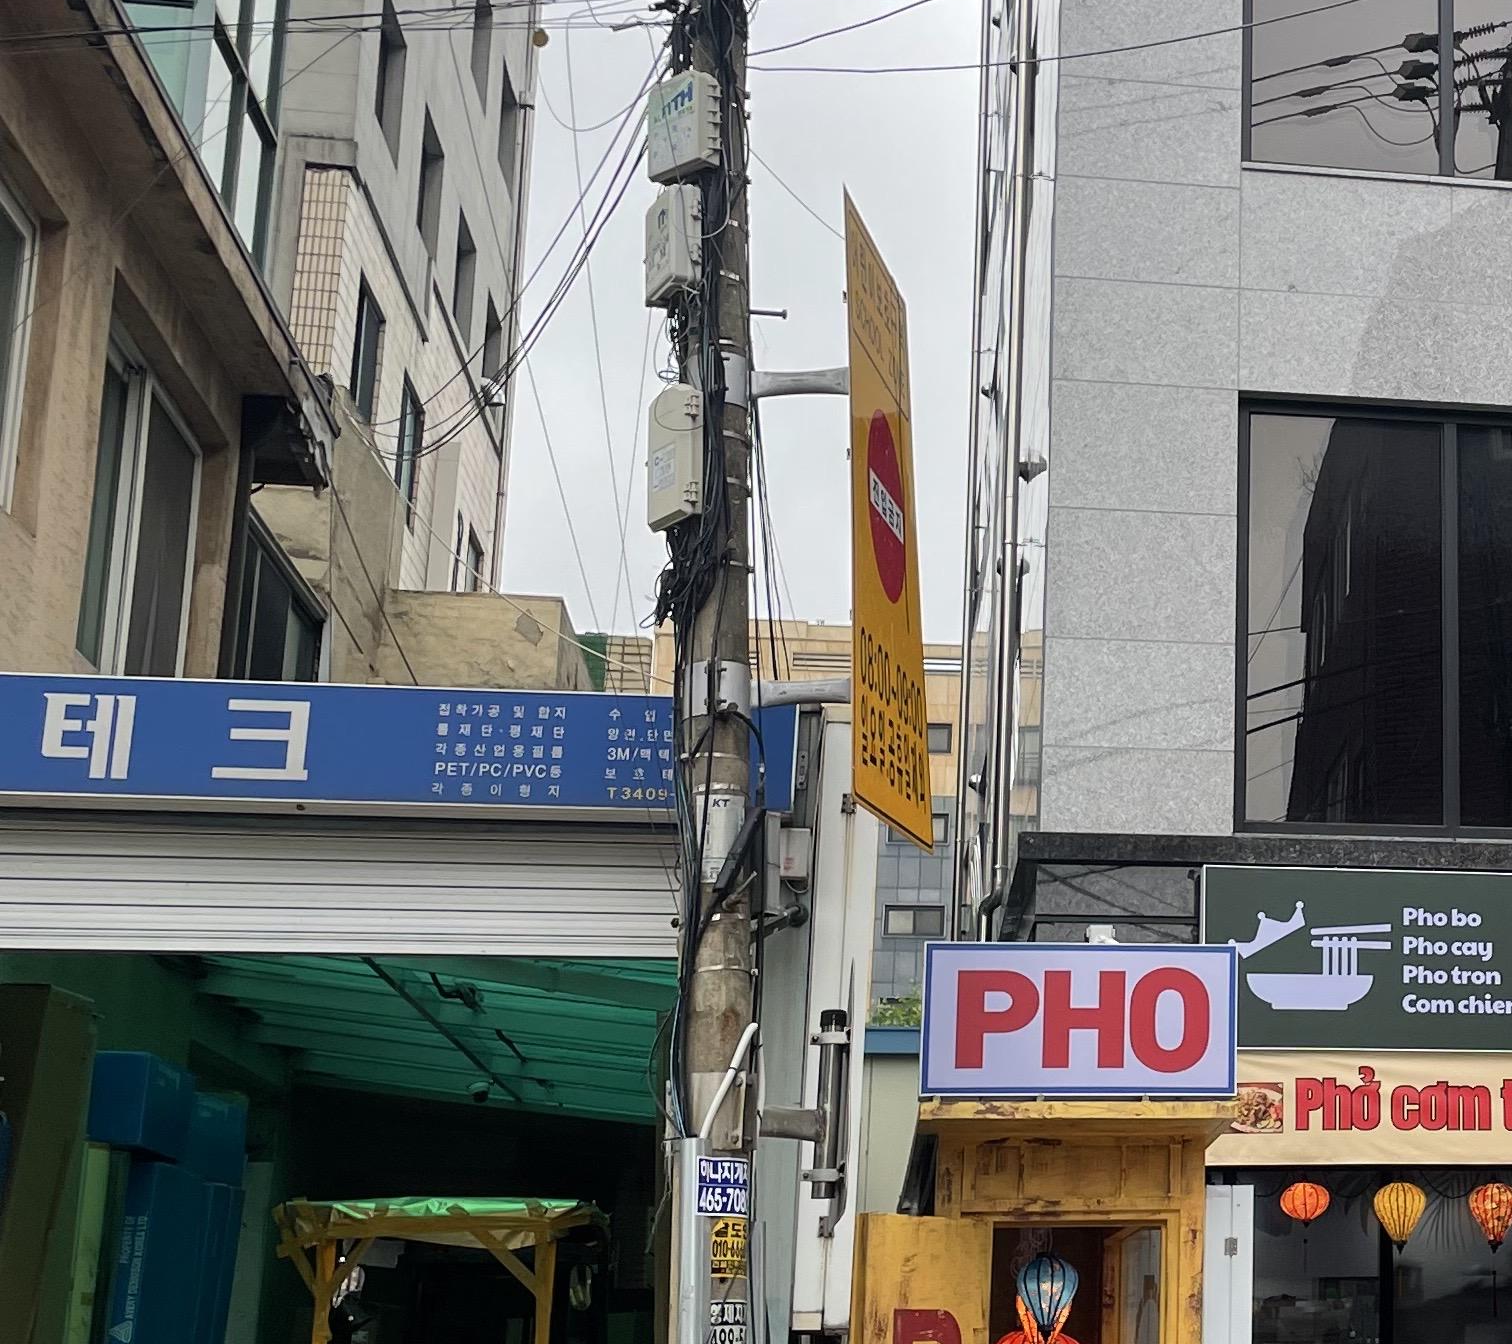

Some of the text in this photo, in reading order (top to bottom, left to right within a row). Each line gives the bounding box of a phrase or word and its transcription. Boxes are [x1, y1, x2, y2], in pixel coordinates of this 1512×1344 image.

[872, 477, 903, 540] 진입금지
[711, 798, 731, 808] KT
[1402, 907, 1482, 927] Pho bo
[1402, 936, 1494, 962] Pho cay
[1402, 965, 1502, 985] Pho tron
[1402, 994, 1454, 1014] Com
[953, 967, 1210, 1074] PHO
[1294, 1065, 1382, 1131] Phở
[1390, 1081, 1493, 1132] cơm
[700, 1159, 749, 1184] 하나지게
[124, 1294, 137, 1320] AVERY
